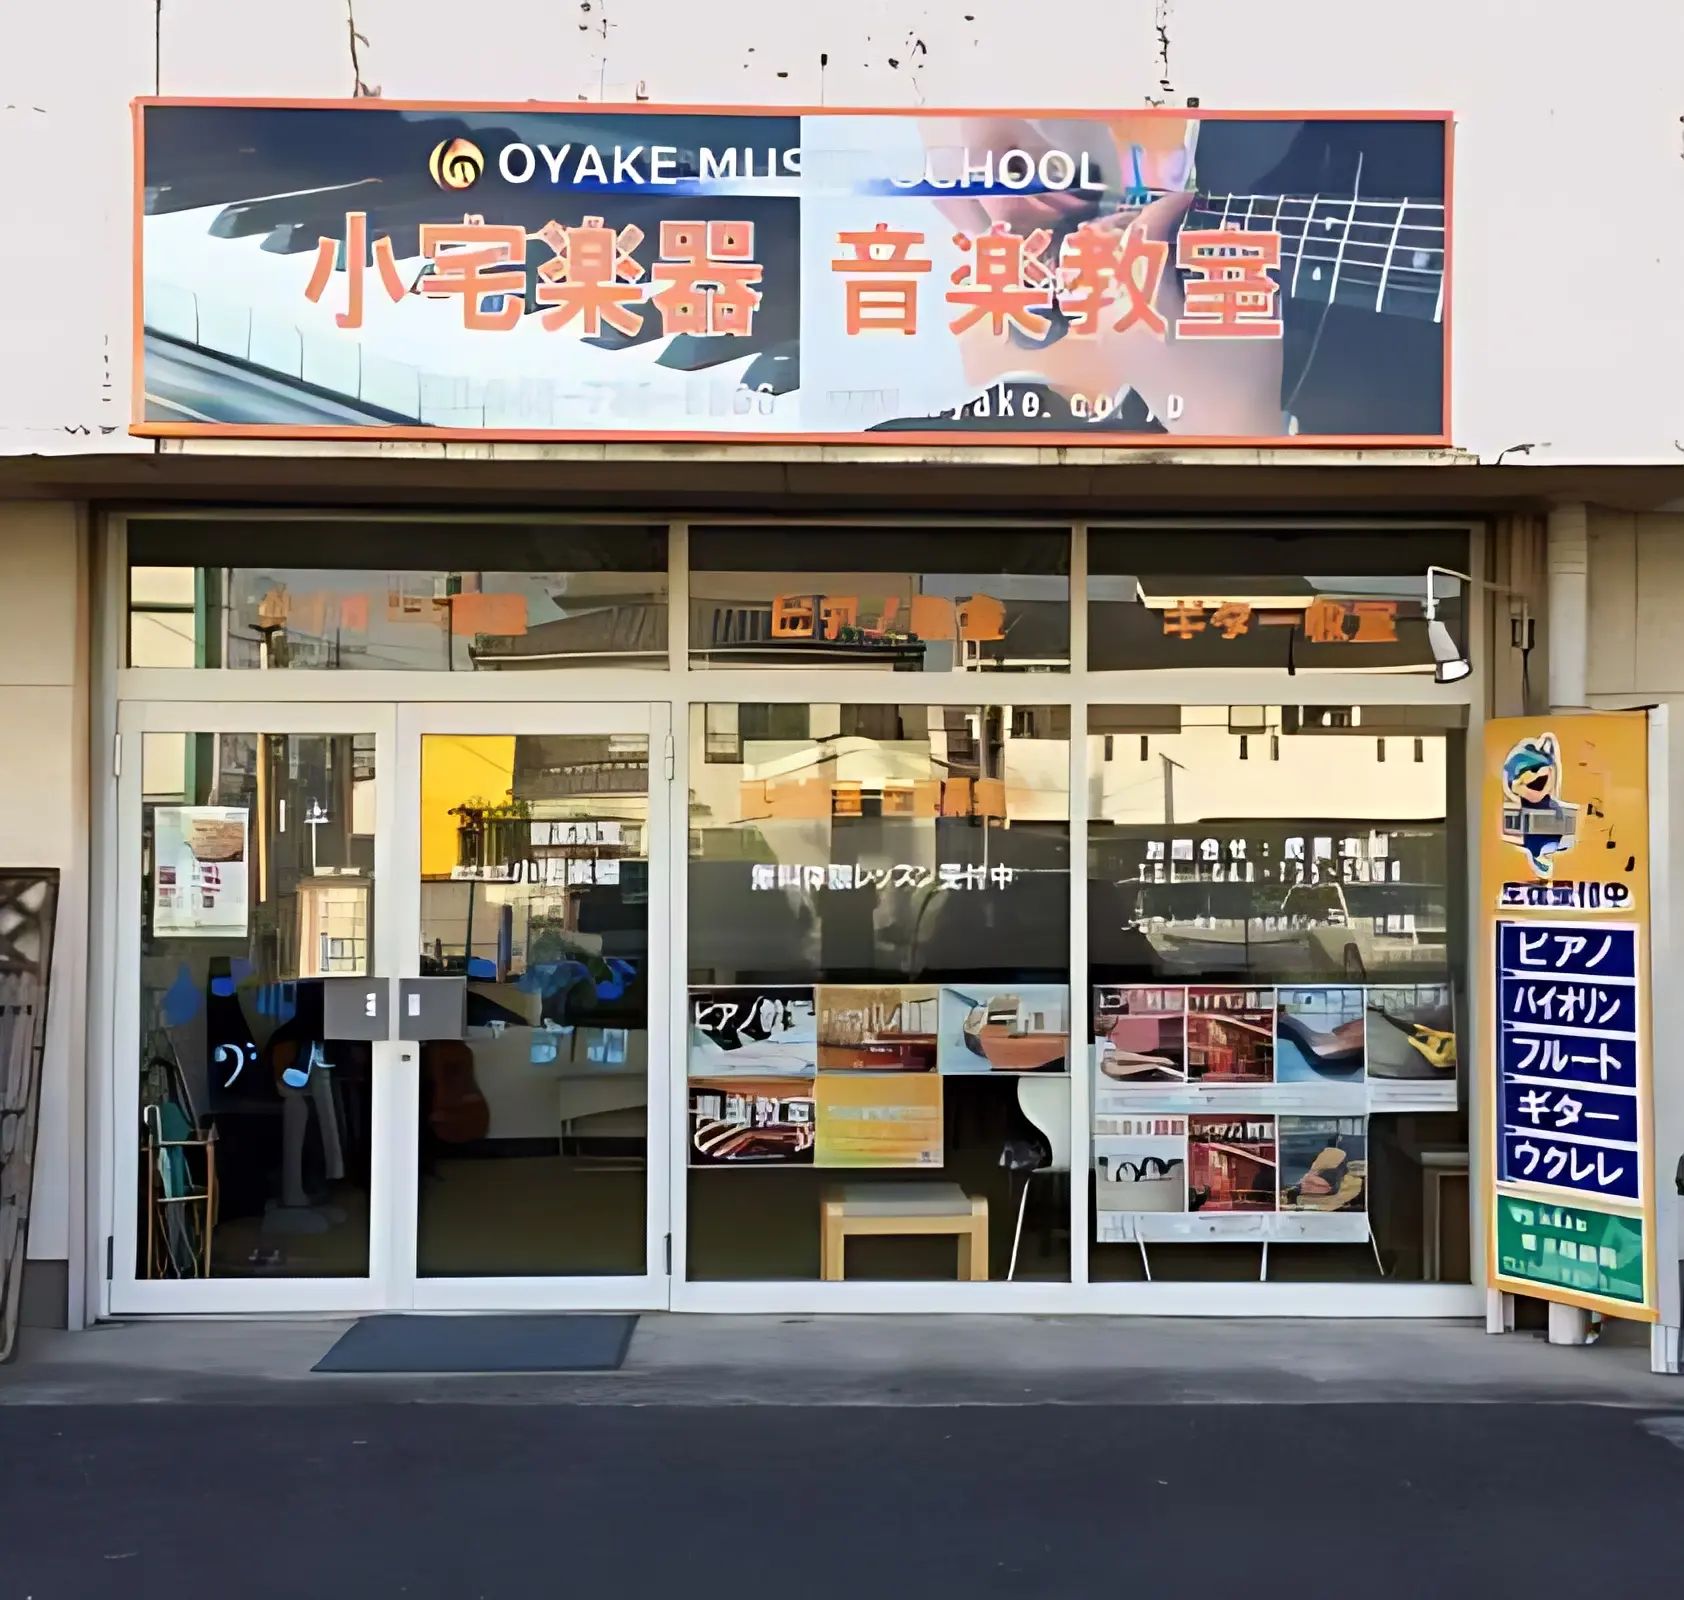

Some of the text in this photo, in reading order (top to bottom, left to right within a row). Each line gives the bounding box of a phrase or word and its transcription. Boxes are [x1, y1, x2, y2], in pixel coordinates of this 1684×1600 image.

[499, 143, 678, 185] OYAKE
[304, 211, 1284, 341] 小宅楽器 音楽教室
[1512, 1037, 1622, 1081] フルート
[1517, 1089, 1620, 1128] ギター
[1514, 1140, 1624, 1186] ウクレレ
